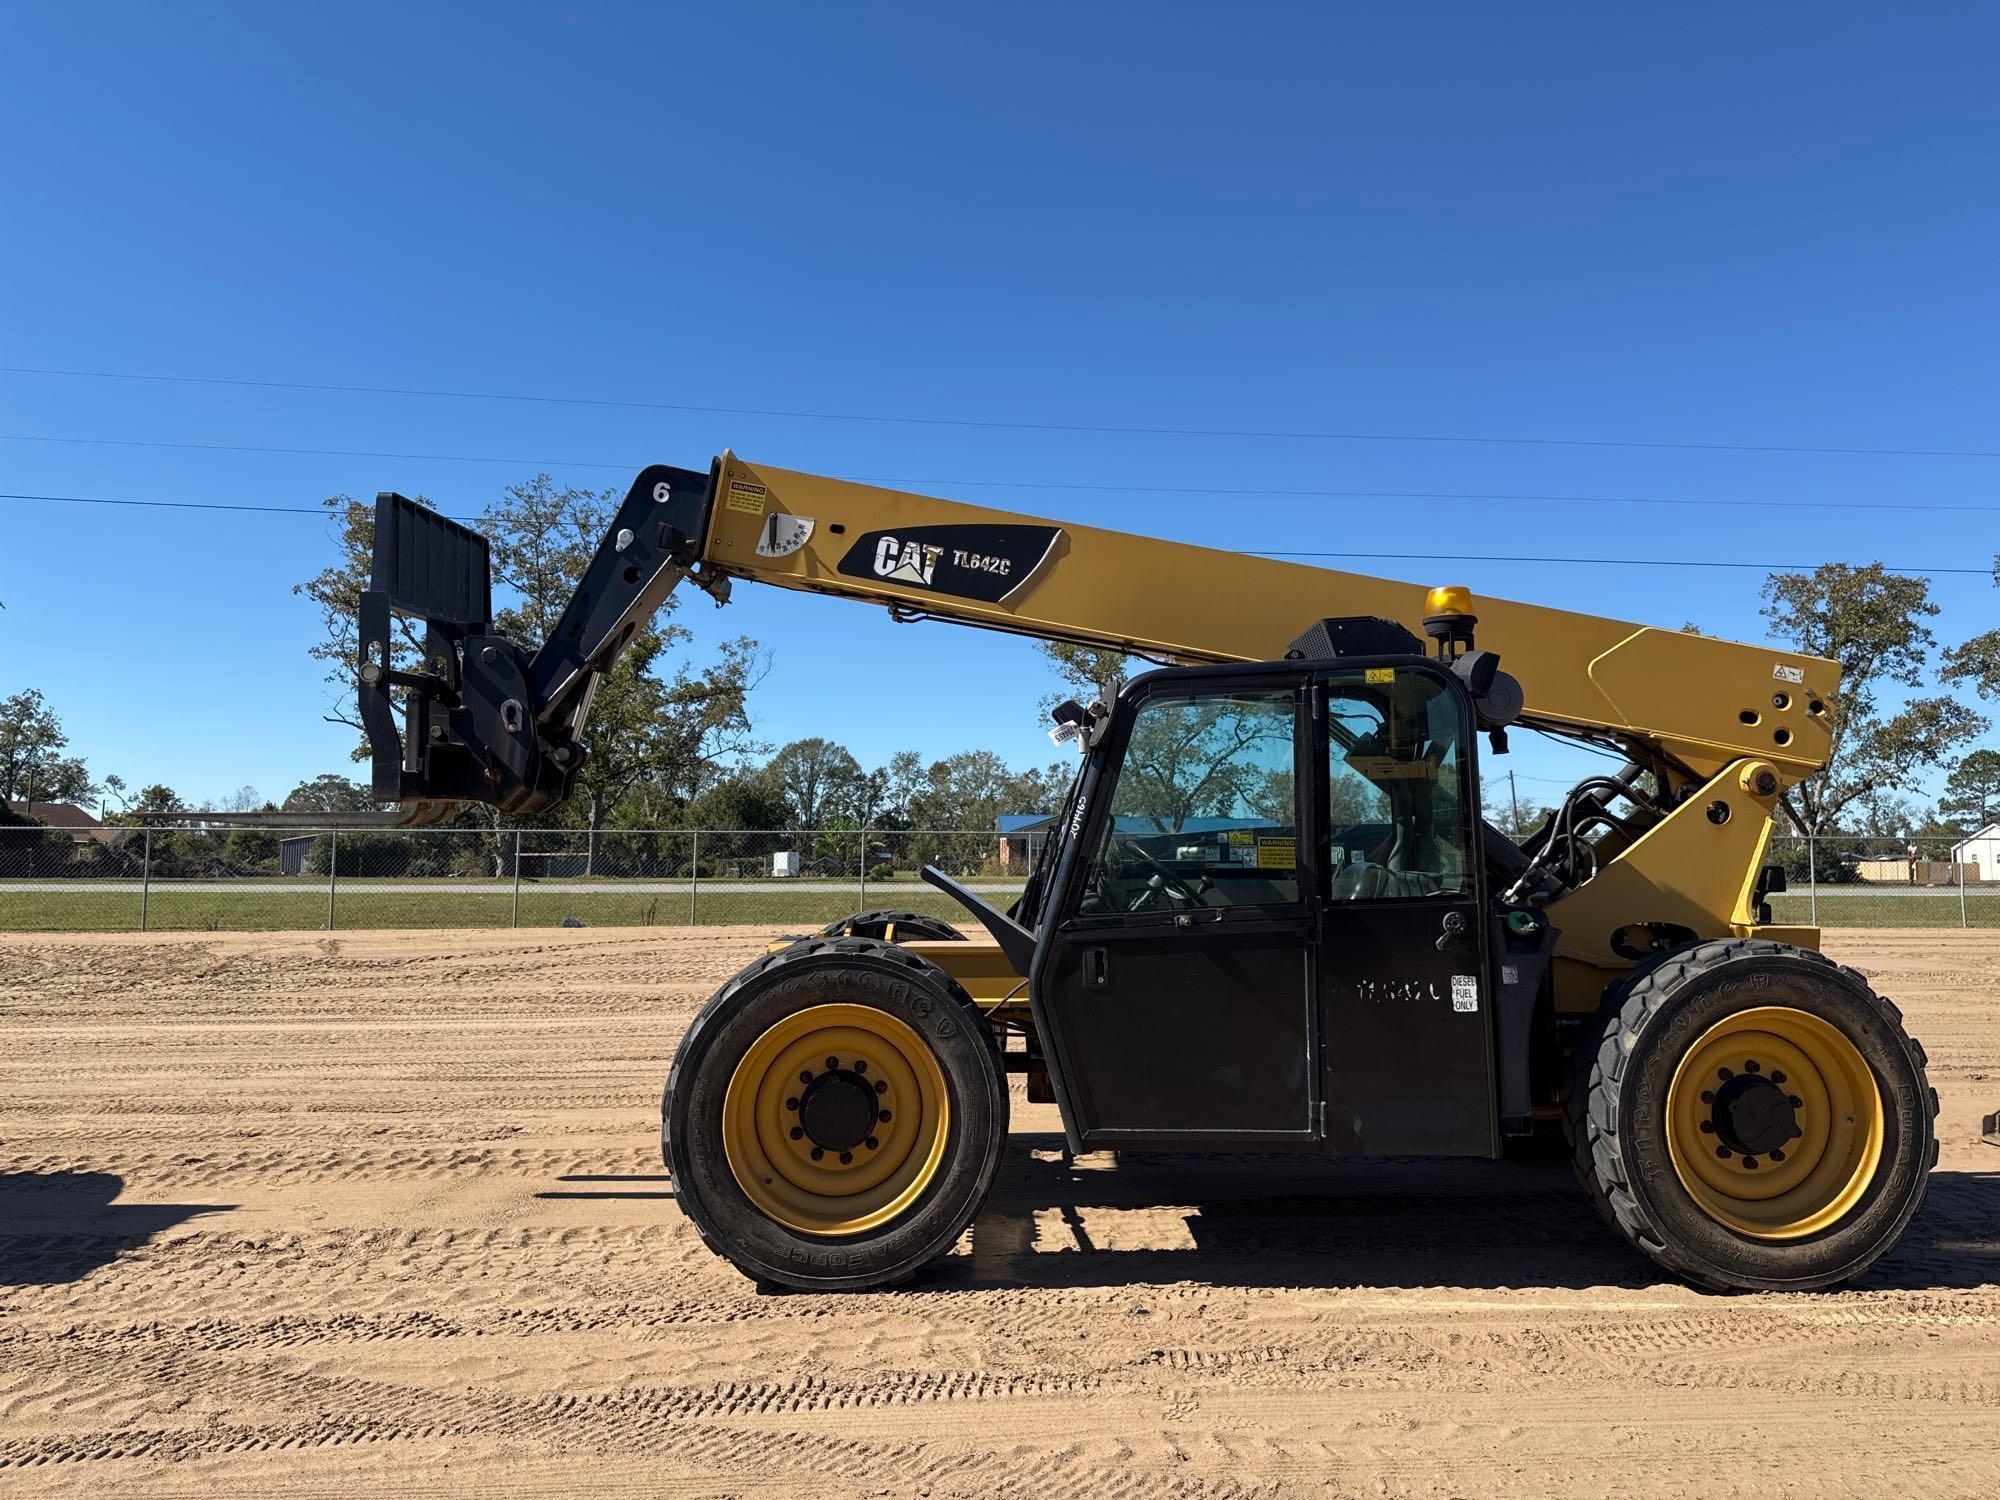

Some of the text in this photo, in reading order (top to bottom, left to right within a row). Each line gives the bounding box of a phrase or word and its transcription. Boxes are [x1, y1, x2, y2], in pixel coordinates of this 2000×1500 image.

[653, 482, 670, 503] 6
[732, 483, 765, 494] WARNING
[874, 536, 1011, 585] CAT TL642C
[1452, 977, 1475, 987] DIESEL
[1456, 988, 1473, 999] FUEL
[1455, 1000, 1474, 1011] ONLY
